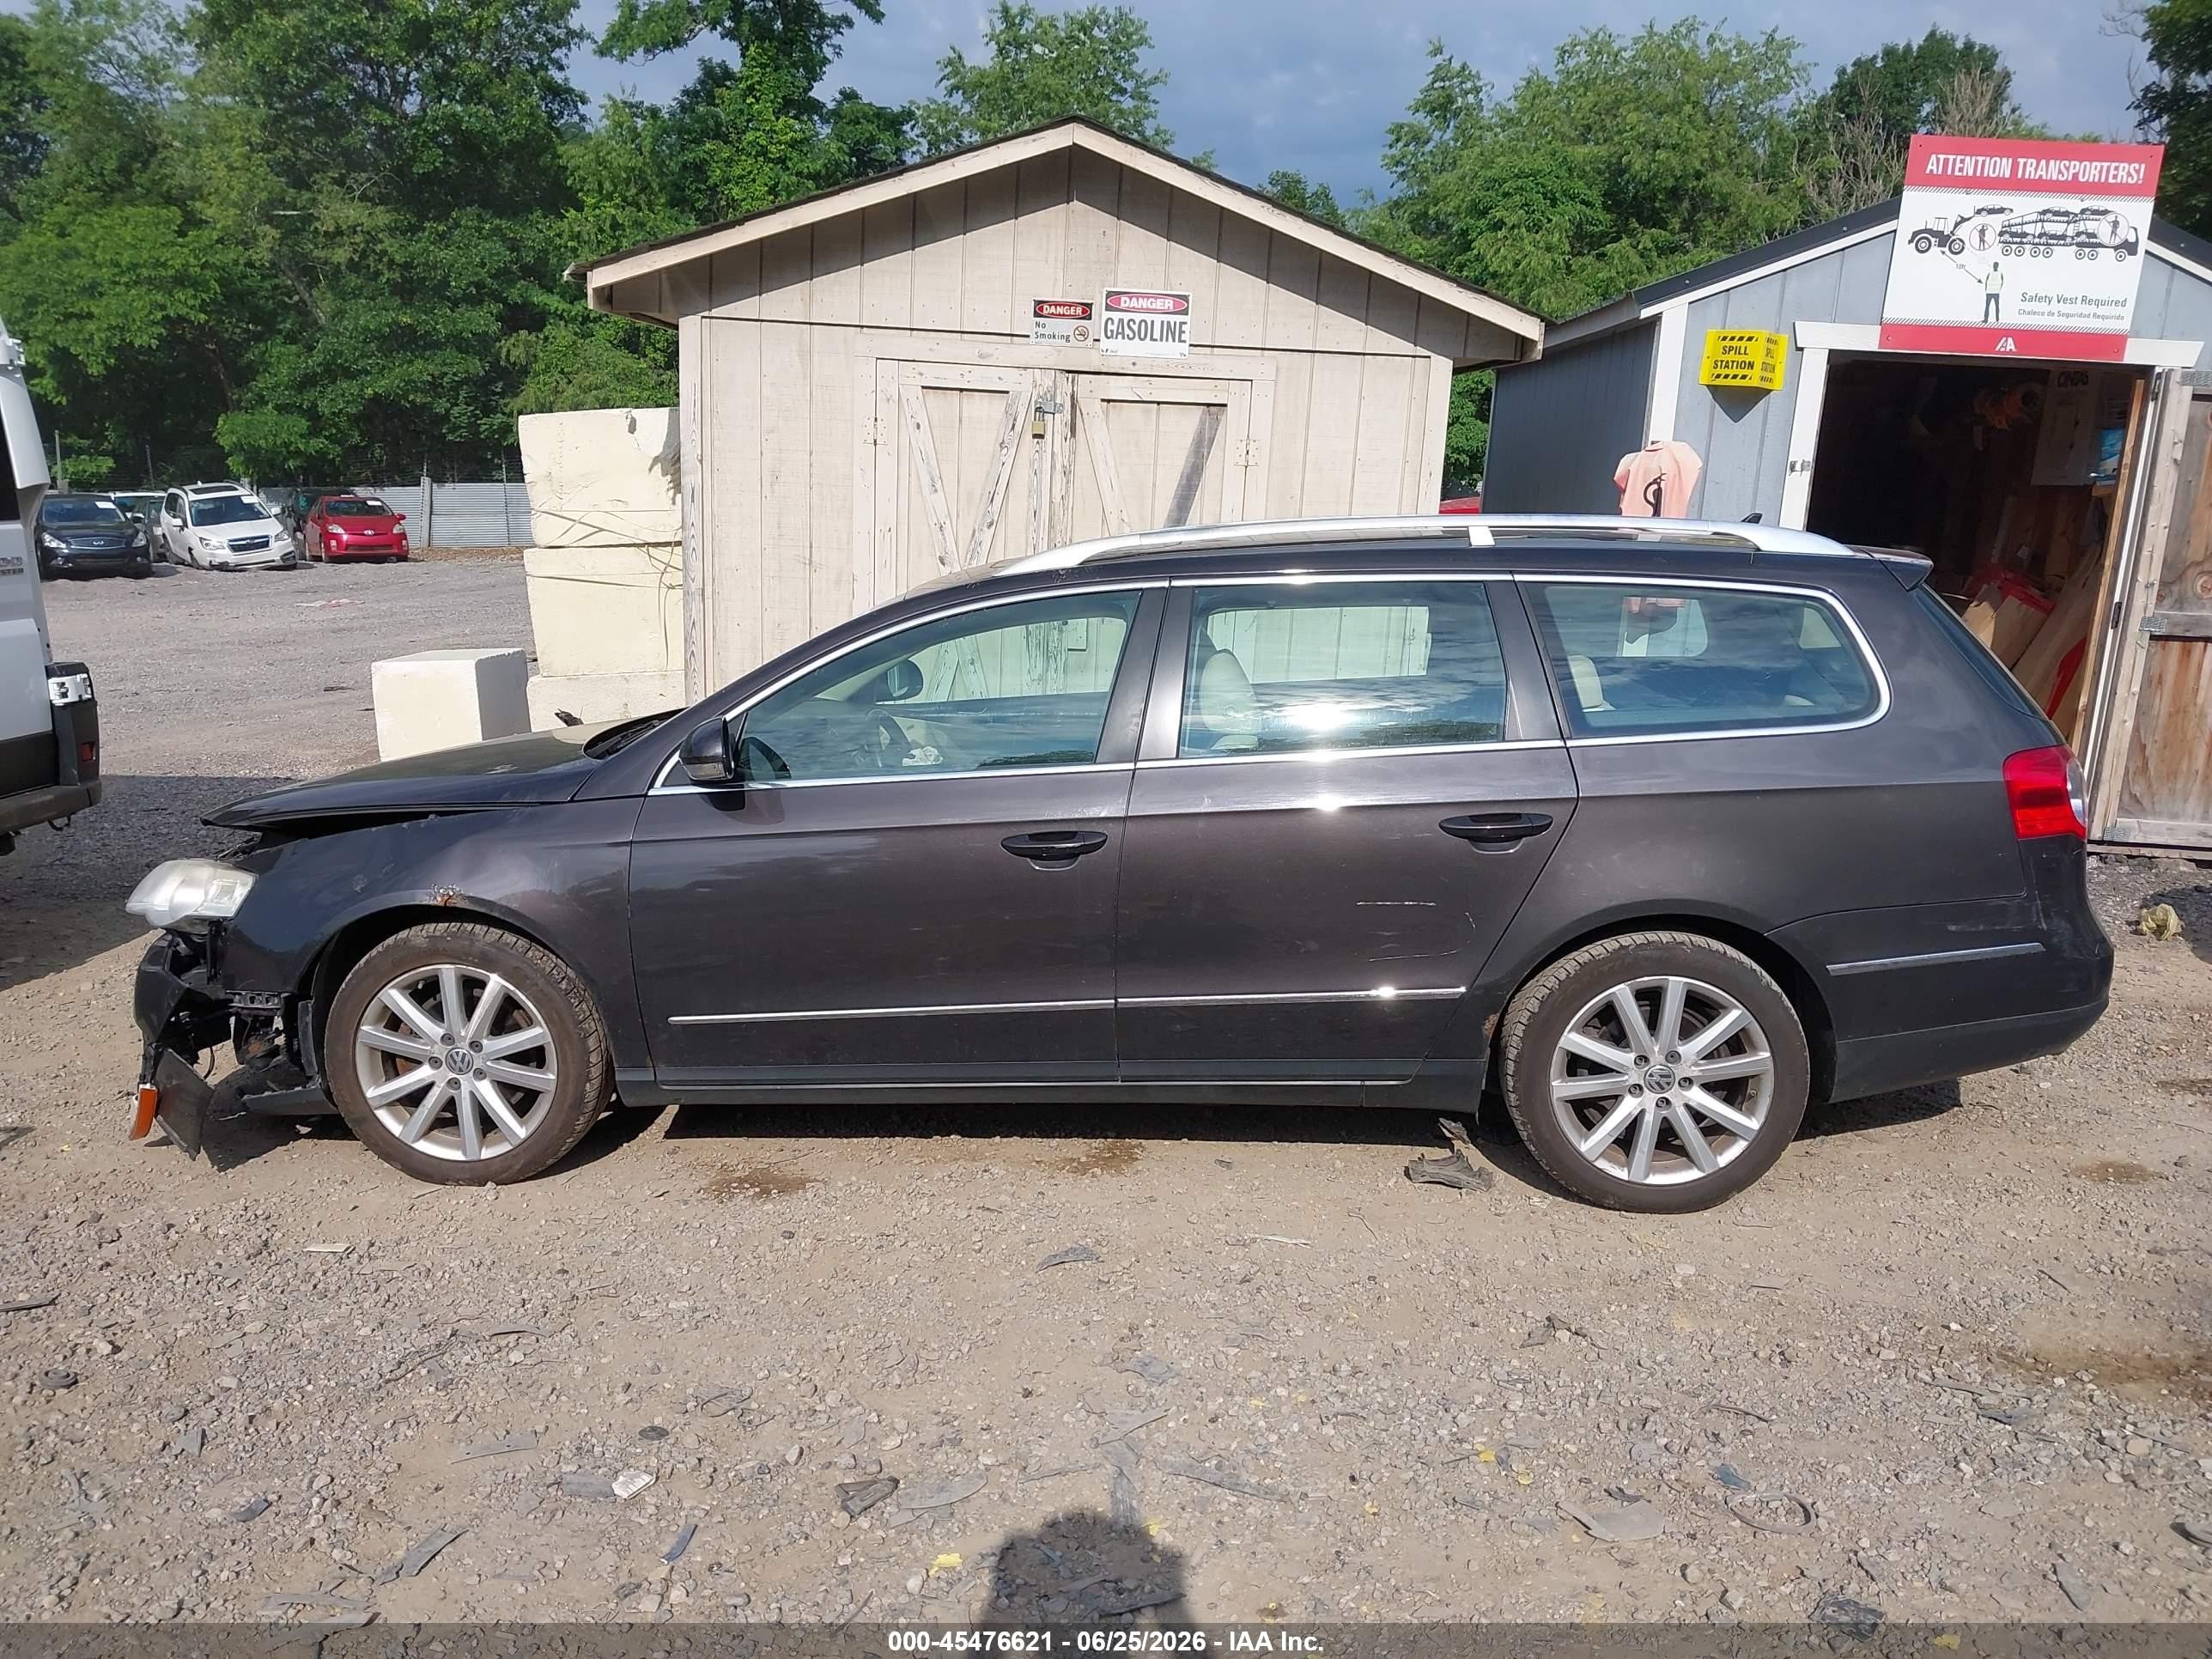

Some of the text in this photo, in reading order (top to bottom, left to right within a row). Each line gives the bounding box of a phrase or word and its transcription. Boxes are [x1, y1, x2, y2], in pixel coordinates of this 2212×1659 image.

[1925, 154, 2146, 185] ATTENTION TRANSPORTERS!
[1121, 296, 1174, 310] DANGER
[2021, 292, 2128, 308] Safety Vest Required
[1042, 305, 1083, 316] DANGER
[2018, 308, 2045, 317] Chaleco
[2057, 310, 2091, 319] Seguridad
[2093, 313, 2125, 321] Requirido
[1035, 320, 1047, 329] No
[1103, 317, 1188, 343] GASOLINE
[1035, 331, 1071, 343] Smoking
[1722, 344, 1749, 356] SPILL
[1765, 347, 1775, 359] SPILL
[1712, 359, 1754, 370] STATION
[1761, 362, 1776, 374] STATION
